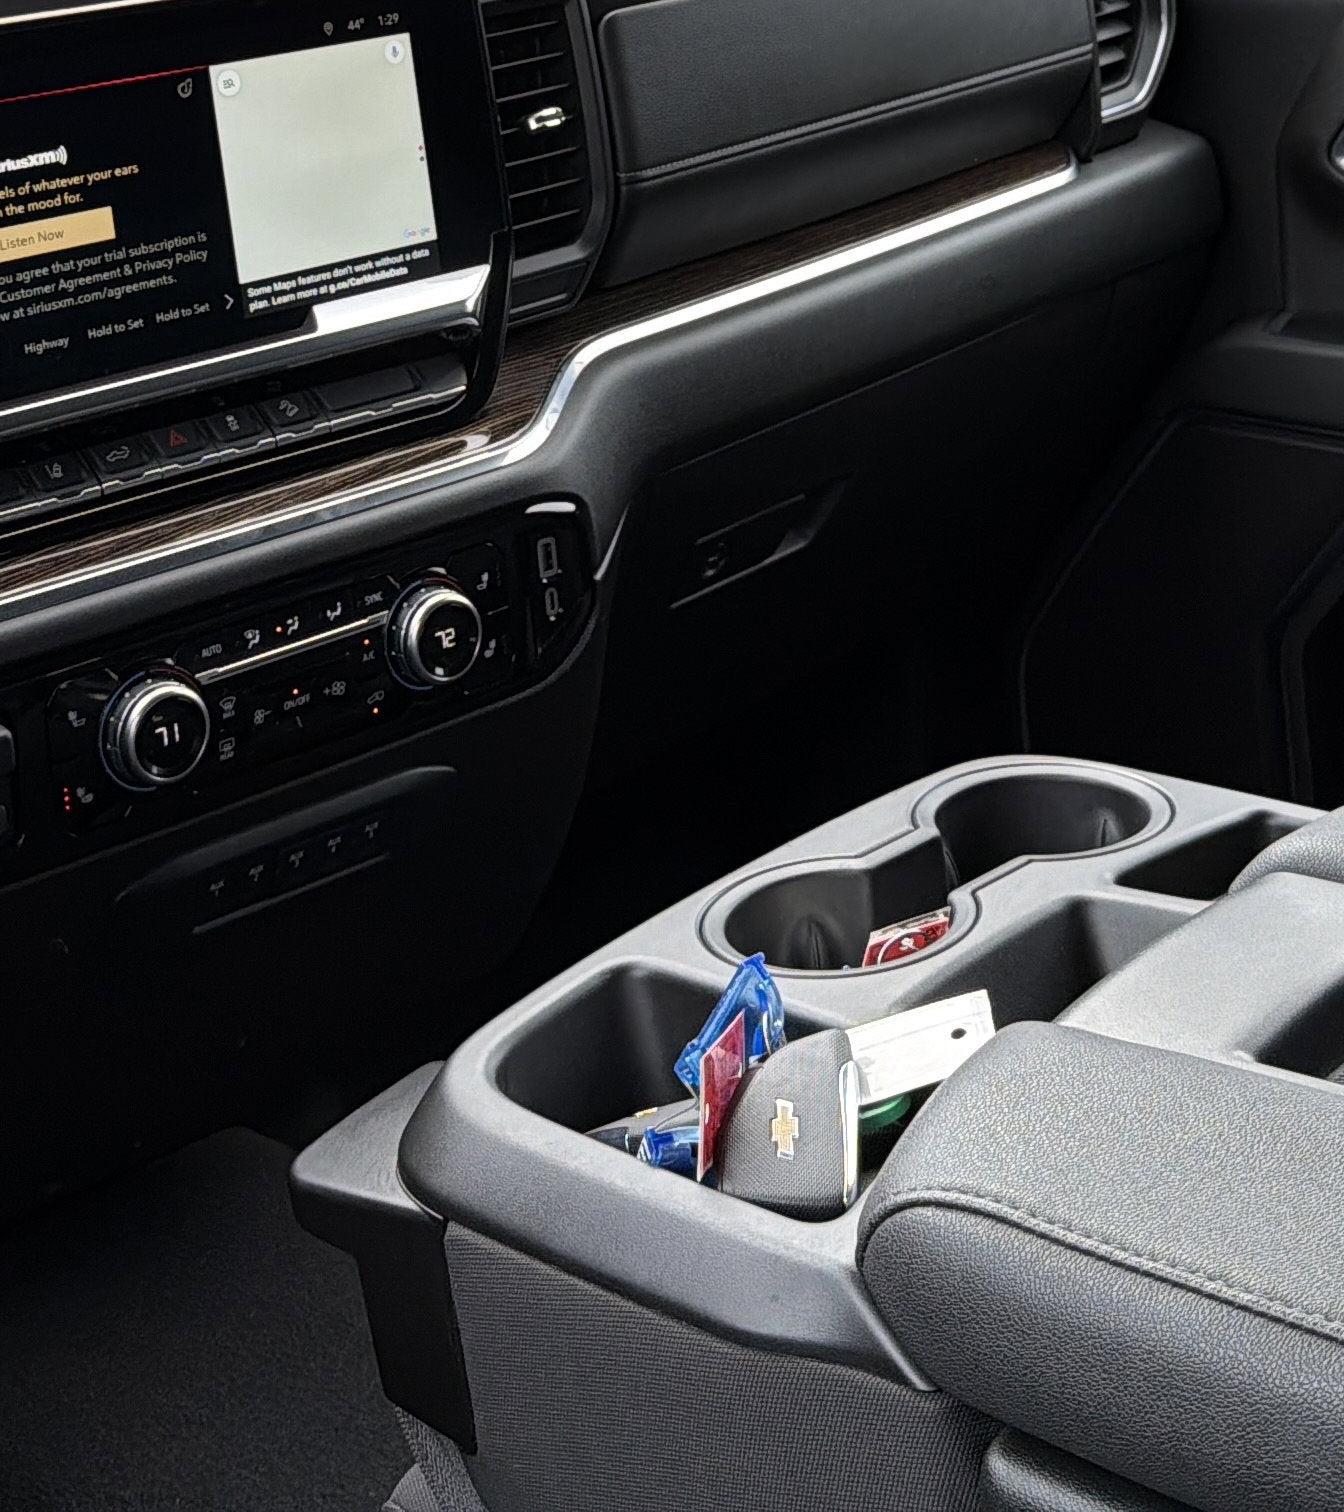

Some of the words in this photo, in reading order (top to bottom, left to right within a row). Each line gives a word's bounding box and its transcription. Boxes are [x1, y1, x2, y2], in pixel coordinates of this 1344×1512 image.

[378, 13, 399, 26] 1:29
[18, 182, 31, 196] of
[32, 174, 84, 193] whatever
[86, 171, 113, 186] your
[114, 165, 139, 177] ears
[5, 203, 25, 217] the
[27, 197, 62, 213] mood
[64, 192, 84, 205] for.
[0, 236, 35, 251] Listen
[38, 229, 65, 243] Now
[15, 268, 49, 284] agree
[51, 260, 76, 274] that
[76, 256, 102, 272] your
[104, 247, 127, 262] trial
[128, 236, 196, 257] subscription
[197, 231, 207, 241] is
[0, 282, 56, 303] Customer
[58, 267, 122, 291] Agreement
[123, 264, 133, 276] &
[135, 257, 174, 273] Privacy
[176, 249, 208, 264] Policy
[247, 285, 272, 298] Some
[273, 279, 296, 294] Maps
[298, 271, 332, 287] features
[333, 264, 354, 279] don't
[354, 261, 374, 273] work
[375, 253, 404, 268] without
[405, 253, 411, 261] a
[412, 248, 430, 260] data
[12, 307, 25, 319] at
[26, 275, 178, 317] siriusxm.com/agreements.
[249, 298, 270, 313] plan.
[272, 293, 295, 305] Learn
[297, 289, 318, 300] more
[319, 286, 328, 295] at
[156, 308, 179, 323] Hold
[181, 307, 192, 317] to
[193, 302, 210, 314] Set
[87, 325, 112, 339] Hold
[114, 322, 126, 333] to
[127, 318, 145, 330] Set
[24, 337, 70, 355] Highway
[364, 591, 384, 606] SYNC
[434, 627, 456, 649] 72
[201, 643, 223, 658] AUTO
[283, 694, 311, 711] ON/OFF
[155, 722, 180, 747] 71
